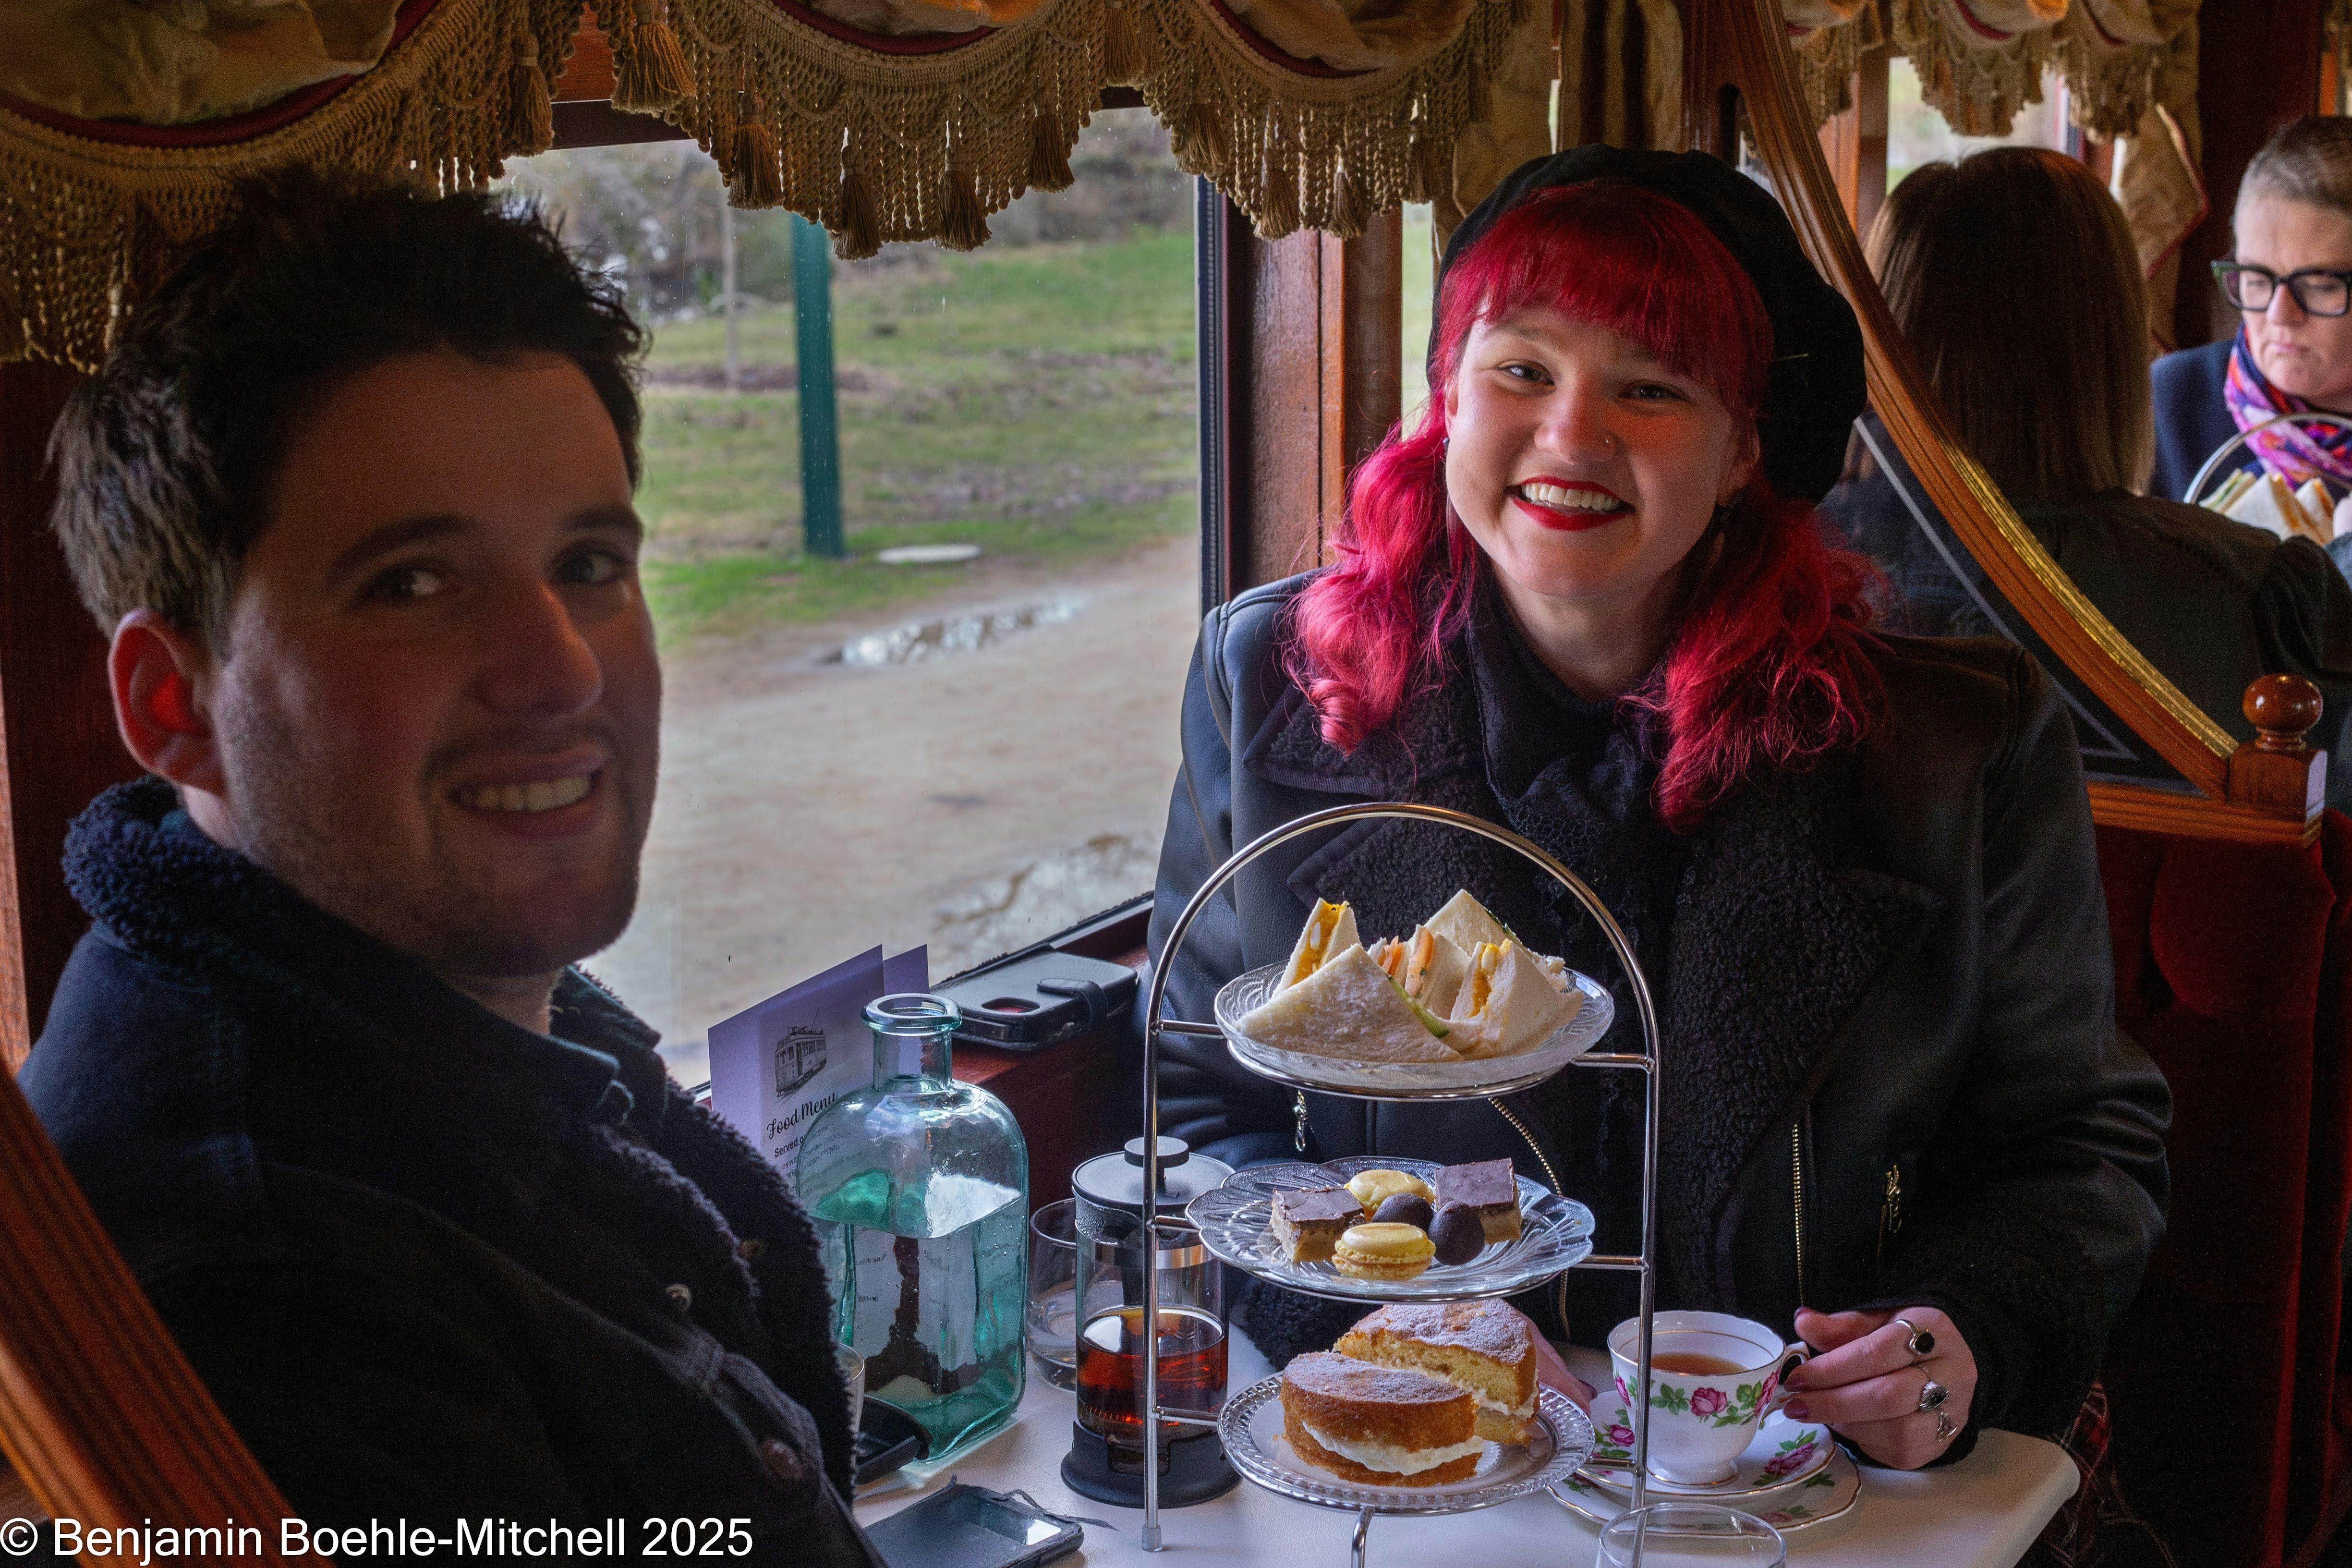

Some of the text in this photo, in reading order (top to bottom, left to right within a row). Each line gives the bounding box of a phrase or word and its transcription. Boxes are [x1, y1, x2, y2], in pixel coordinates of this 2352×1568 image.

[767, 1108, 800, 1140] Food
[801, 1093, 838, 1120] Menu
[775, 1137, 798, 1158] Served
